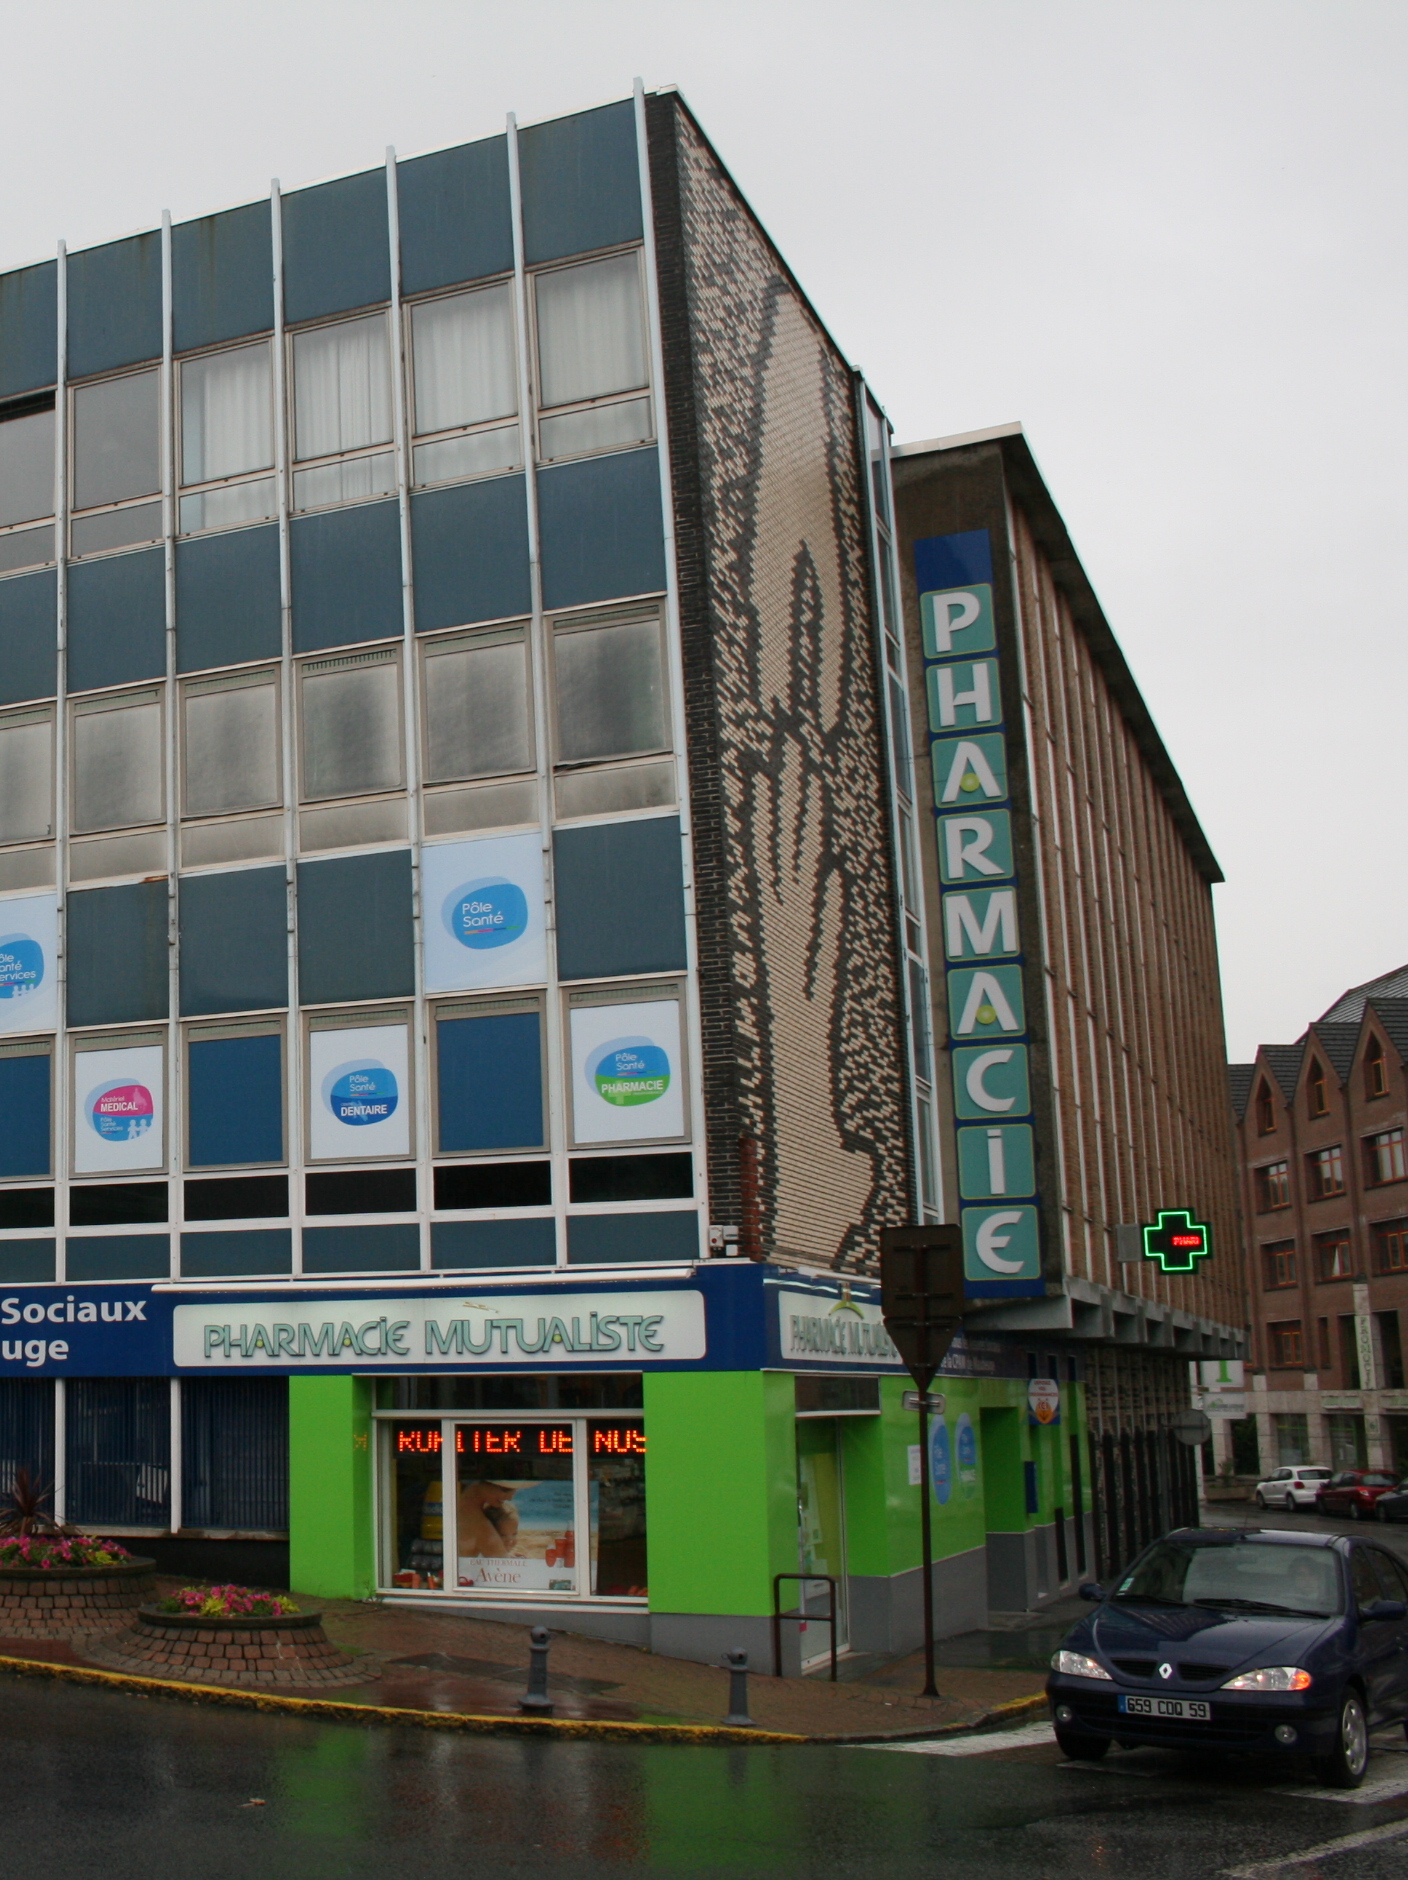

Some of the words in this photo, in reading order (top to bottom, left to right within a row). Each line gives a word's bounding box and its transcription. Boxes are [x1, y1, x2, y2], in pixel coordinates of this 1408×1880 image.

[462, 901, 492, 914] Pôle
[462, 911, 504, 927] Santé
[931, 591, 1025, 1275] PHARMACIE
[615, 1053, 637, 1061] Pôle
[616, 1060, 645, 1071] Santé
[349, 1075, 369, 1083] Pôle
[350, 1082, 376, 1091] Santé
[601, 1080, 663, 1093] PHARMACIE
[100, 1101, 138, 1112] MEDICAL
[341, 1104, 387, 1116] DENTAIRE
[1, 1295, 148, 1324] Sociaux
[204, 1316, 410, 1357] PHARMACIE
[424, 1311, 665, 1354] MUTUALISTE
[476, 1567, 522, 1583] Avène
[1127, 1697, 1152, 1713] 659
[1158, 1700, 1183, 1716] CDQ
[1189, 1703, 1207, 1718] 59
